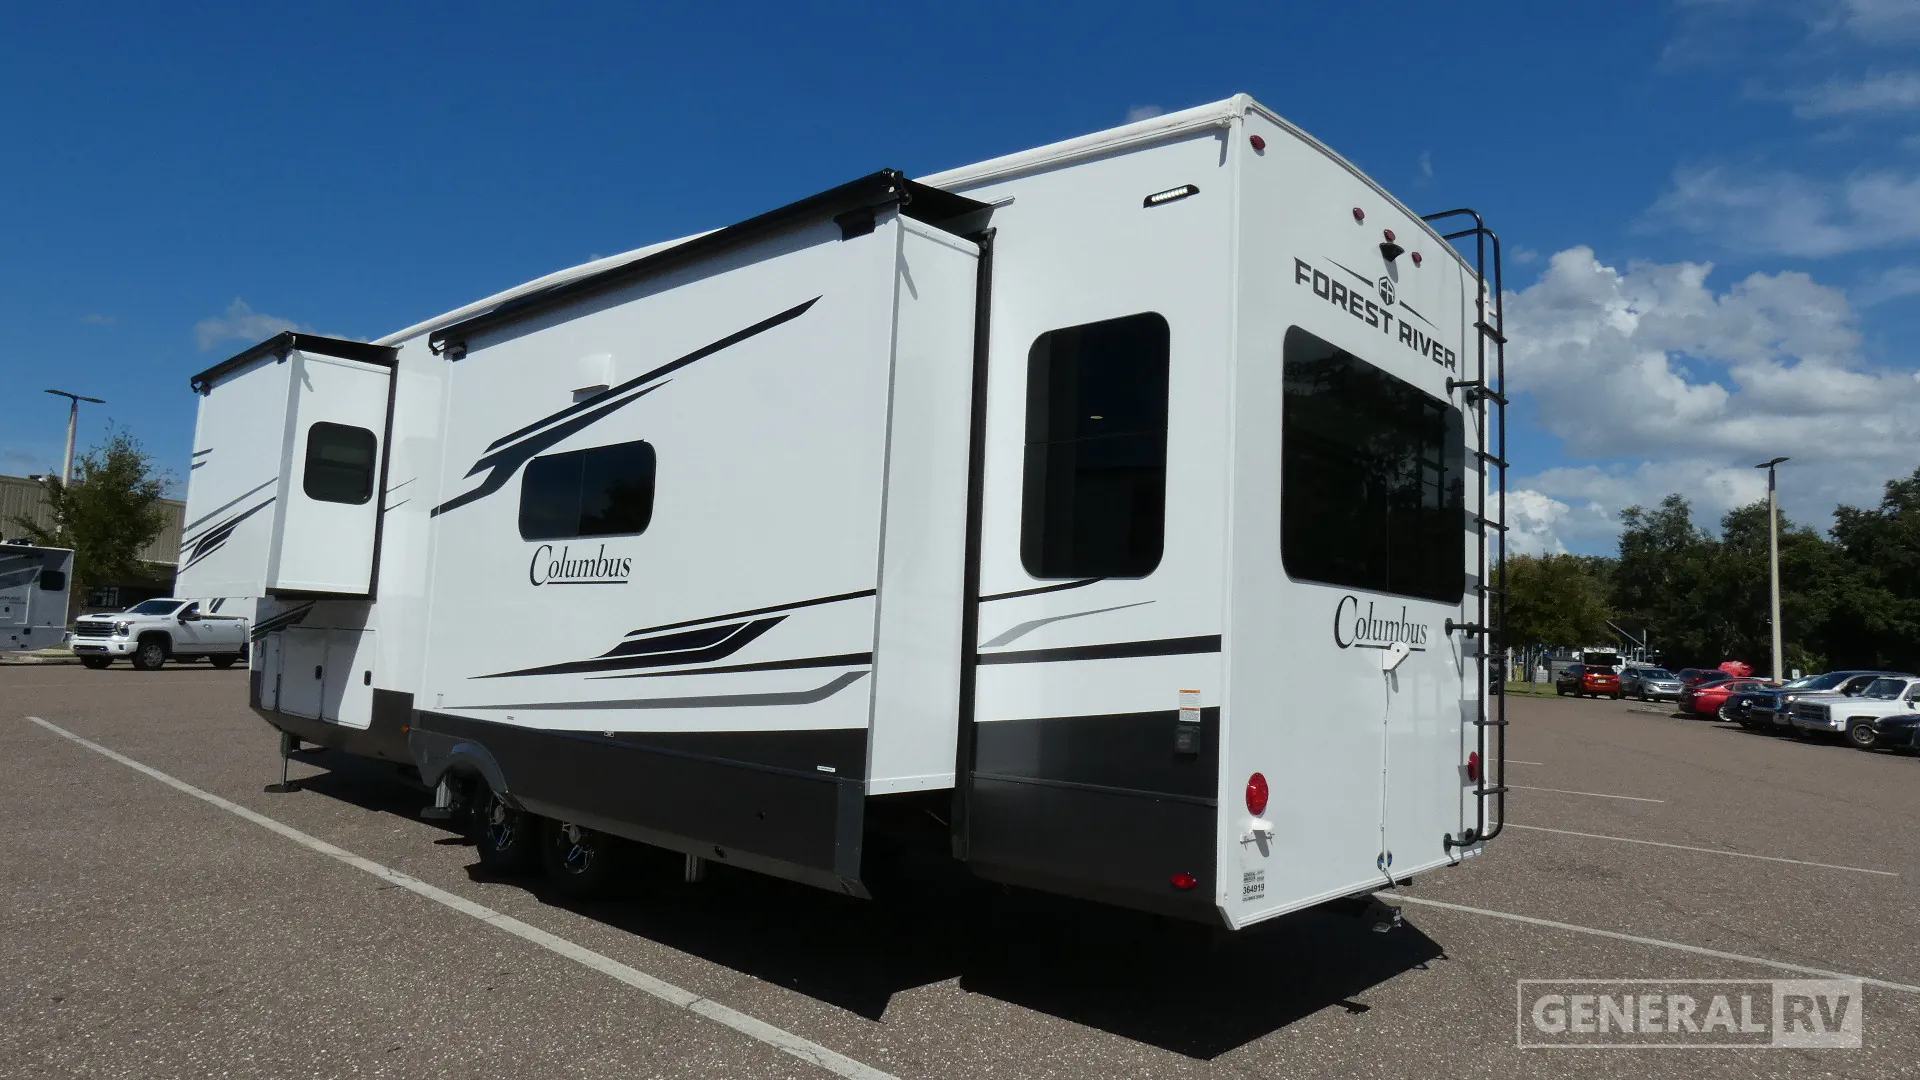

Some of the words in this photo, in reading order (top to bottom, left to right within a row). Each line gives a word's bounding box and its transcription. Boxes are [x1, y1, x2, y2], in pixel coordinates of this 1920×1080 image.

[1293, 256, 1394, 335] FOREST
[1397, 318, 1456, 374] RIVER
[529, 543, 632, 587] Columbus
[1333, 594, 1428, 649] Columbus
[1242, 883, 1265, 895] 364919
